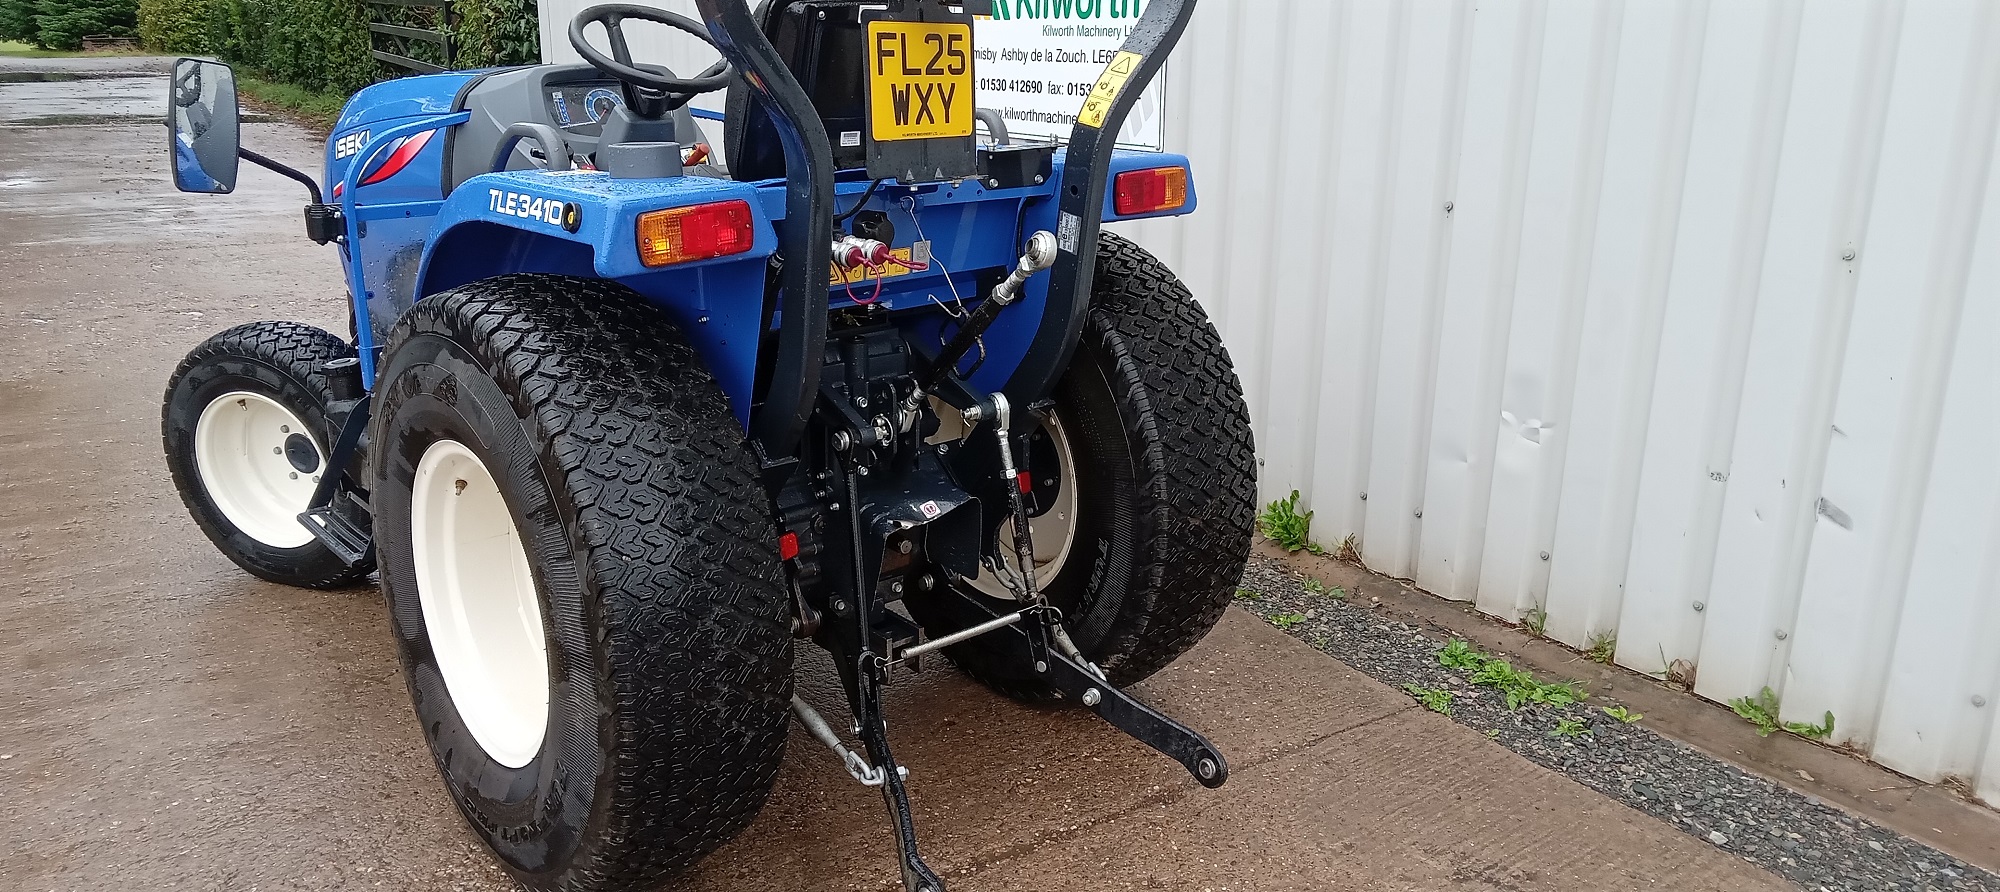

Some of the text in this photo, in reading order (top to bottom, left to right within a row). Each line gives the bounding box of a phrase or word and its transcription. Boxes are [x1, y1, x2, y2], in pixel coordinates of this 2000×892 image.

[1042, 25, 1074, 37] Kilworth
[1077, 25, 1121, 40] Machinery
[876, 32, 966, 76] FL25
[1001, 48, 1028, 65] Ashby
[1030, 49, 1042, 63] de
[1044, 49, 1053, 63] la
[1055, 49, 1089, 64] Zouch.
[980, 78, 1007, 92] 01530
[1009, 79, 1043, 93] 412690
[1047, 80, 1064, 95] fax:
[891, 83, 956, 126] WXY
[335, 130, 370, 160] ISEKI
[489, 188, 564, 226] TLE3410
